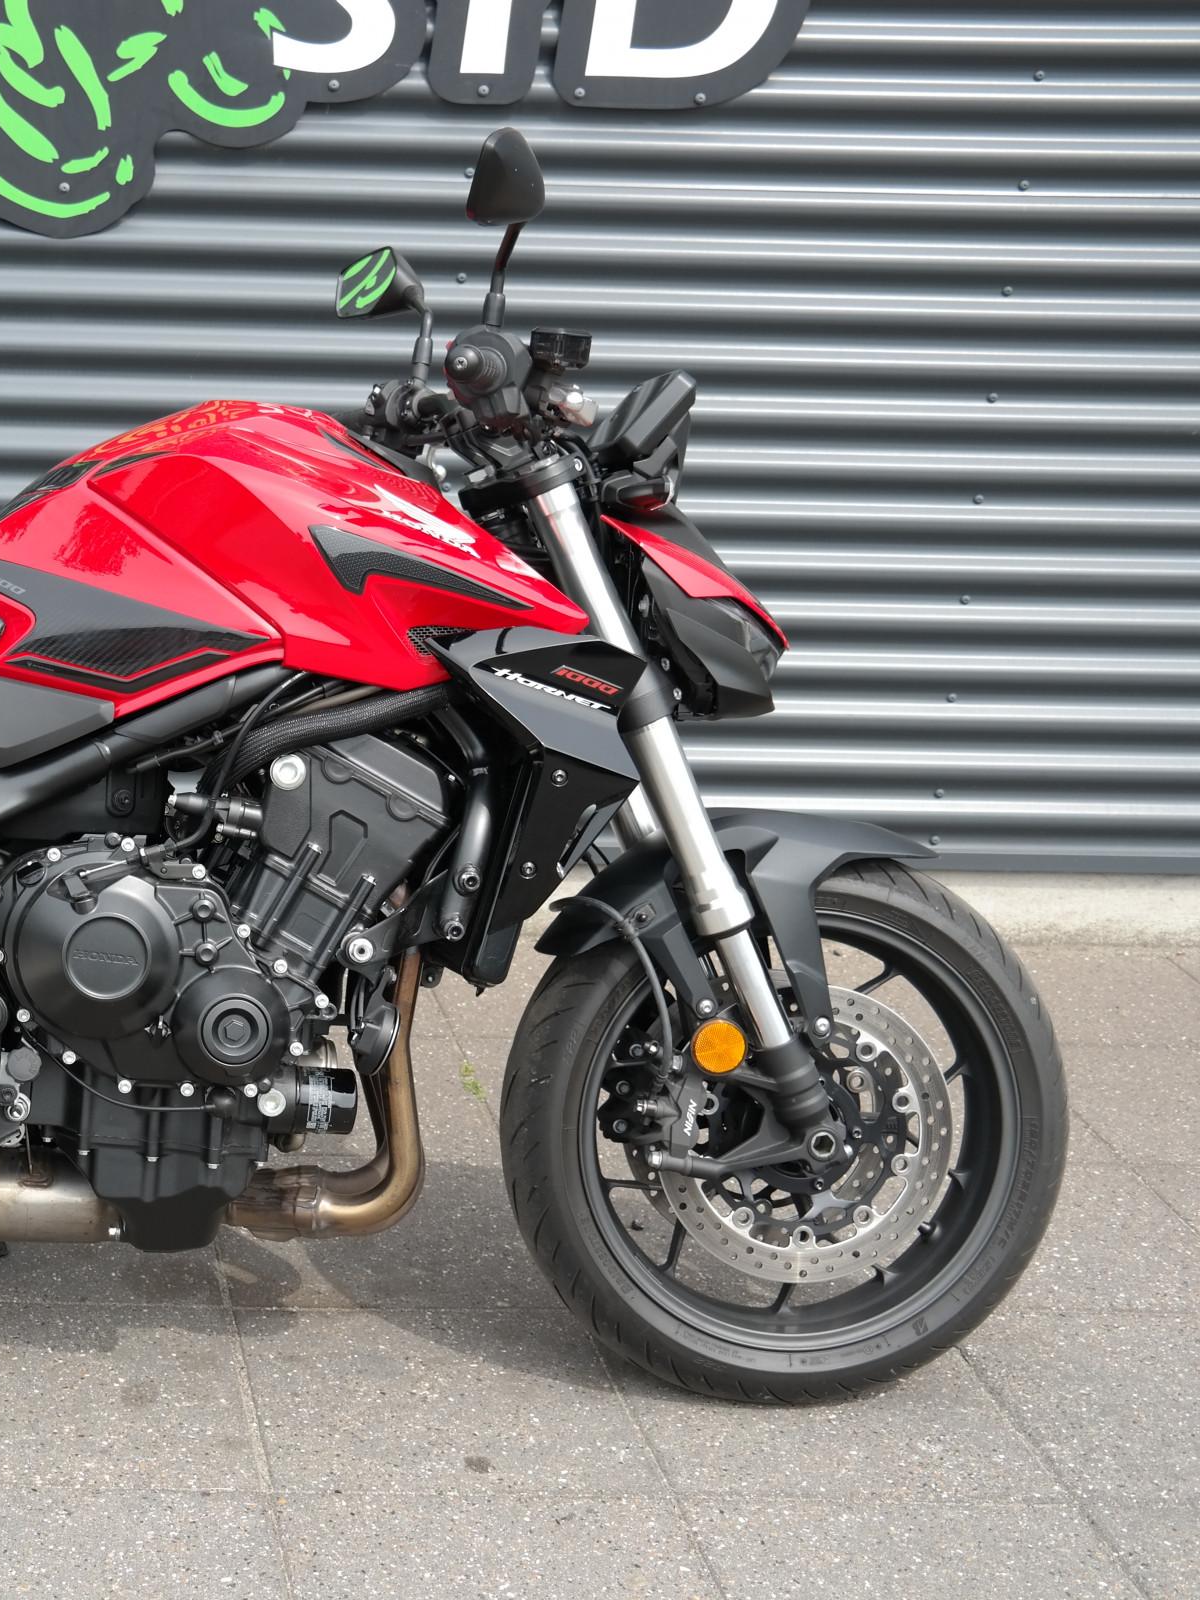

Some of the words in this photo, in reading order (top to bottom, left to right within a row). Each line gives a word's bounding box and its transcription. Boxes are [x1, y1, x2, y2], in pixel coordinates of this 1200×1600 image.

[491, 666, 612, 710] HORNET
[555, 668, 620, 696] 1000
[72, 949, 140, 968] HONDA
